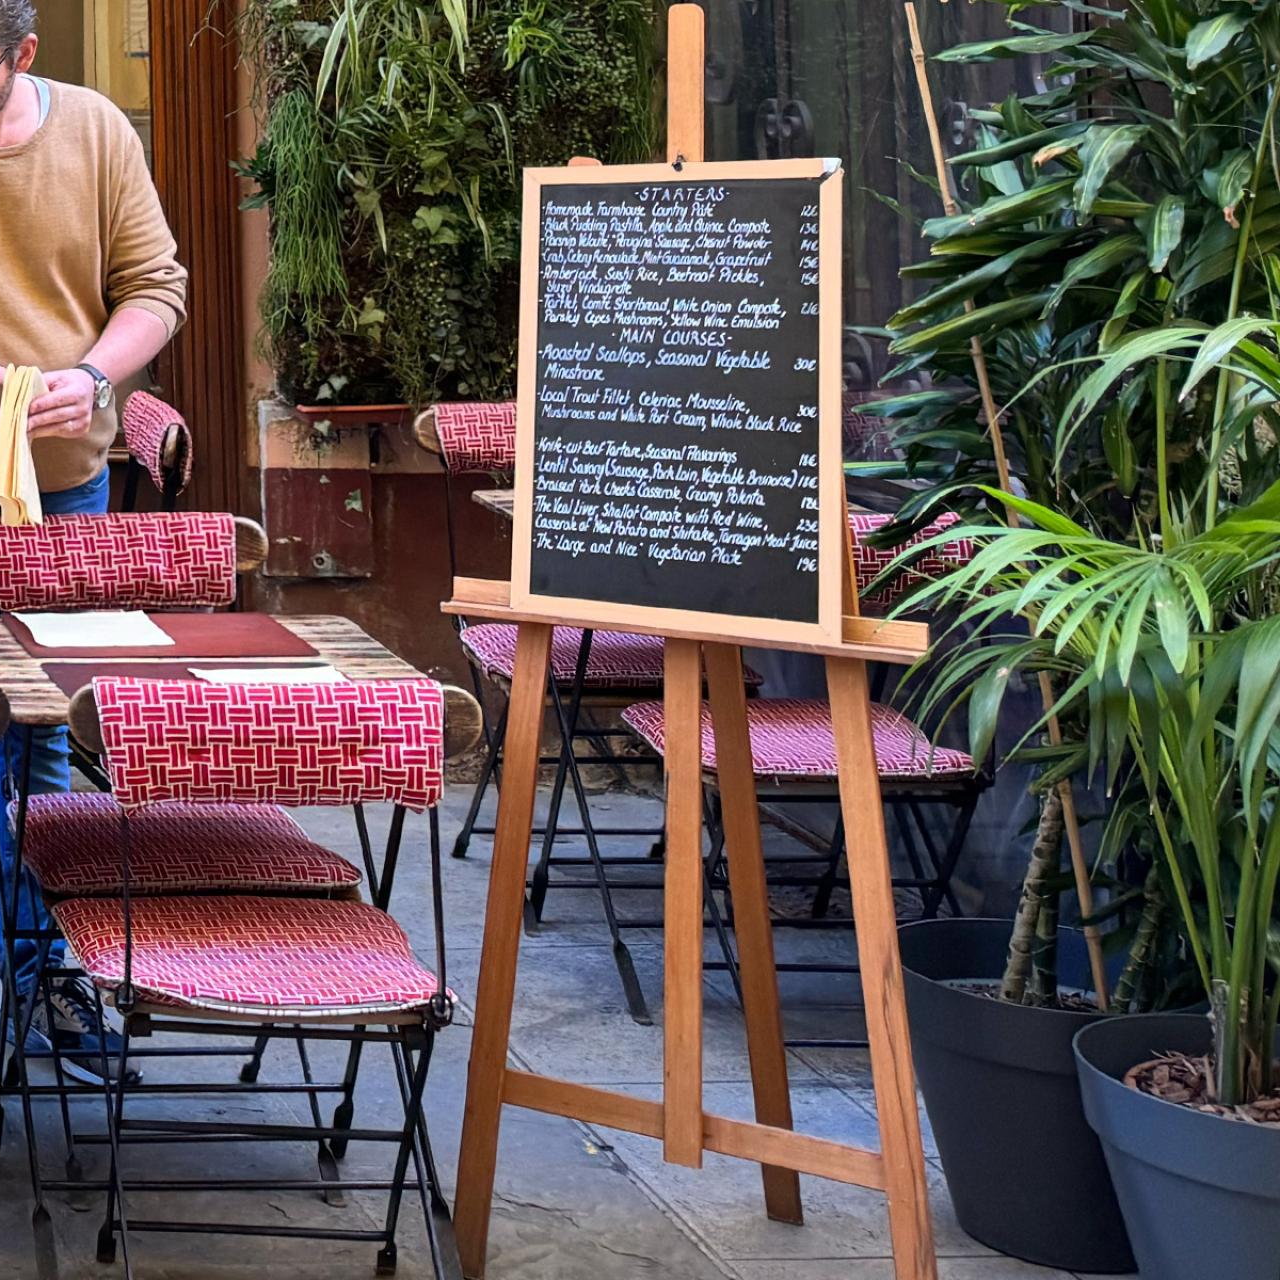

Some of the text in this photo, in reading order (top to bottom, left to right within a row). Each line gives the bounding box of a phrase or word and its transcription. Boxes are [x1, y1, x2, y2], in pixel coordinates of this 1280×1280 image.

[728, 218, 771, 237] Compote
[800, 222, 819, 235] 13€
[715, 251, 819, 269] Grapefruit 15€
[801, 271, 819, 286] 15€
[704, 312, 728, 327] Wine
[731, 315, 780, 328] Emulsion
[620, 327, 655, 343] MAIN
[655, 348, 711, 367] Seasonal
[715, 350, 771, 374] Vegetable
[793, 358, 817, 371] 30€
[597, 407, 619, 421] and
[777, 416, 802, 433] Rice
[797, 404, 817, 418] 30€
[685, 508, 709, 524] with
[710, 510, 736, 526] Red
[796, 518, 818, 532] 23€
[649, 523, 671, 539] and
[789, 534, 818, 551] Juice
[590, 538, 614, 555] and
[648, 543, 706, 566] Vegetarian
[711, 546, 743, 565] Plate
[796, 557, 817, 572] 19€
